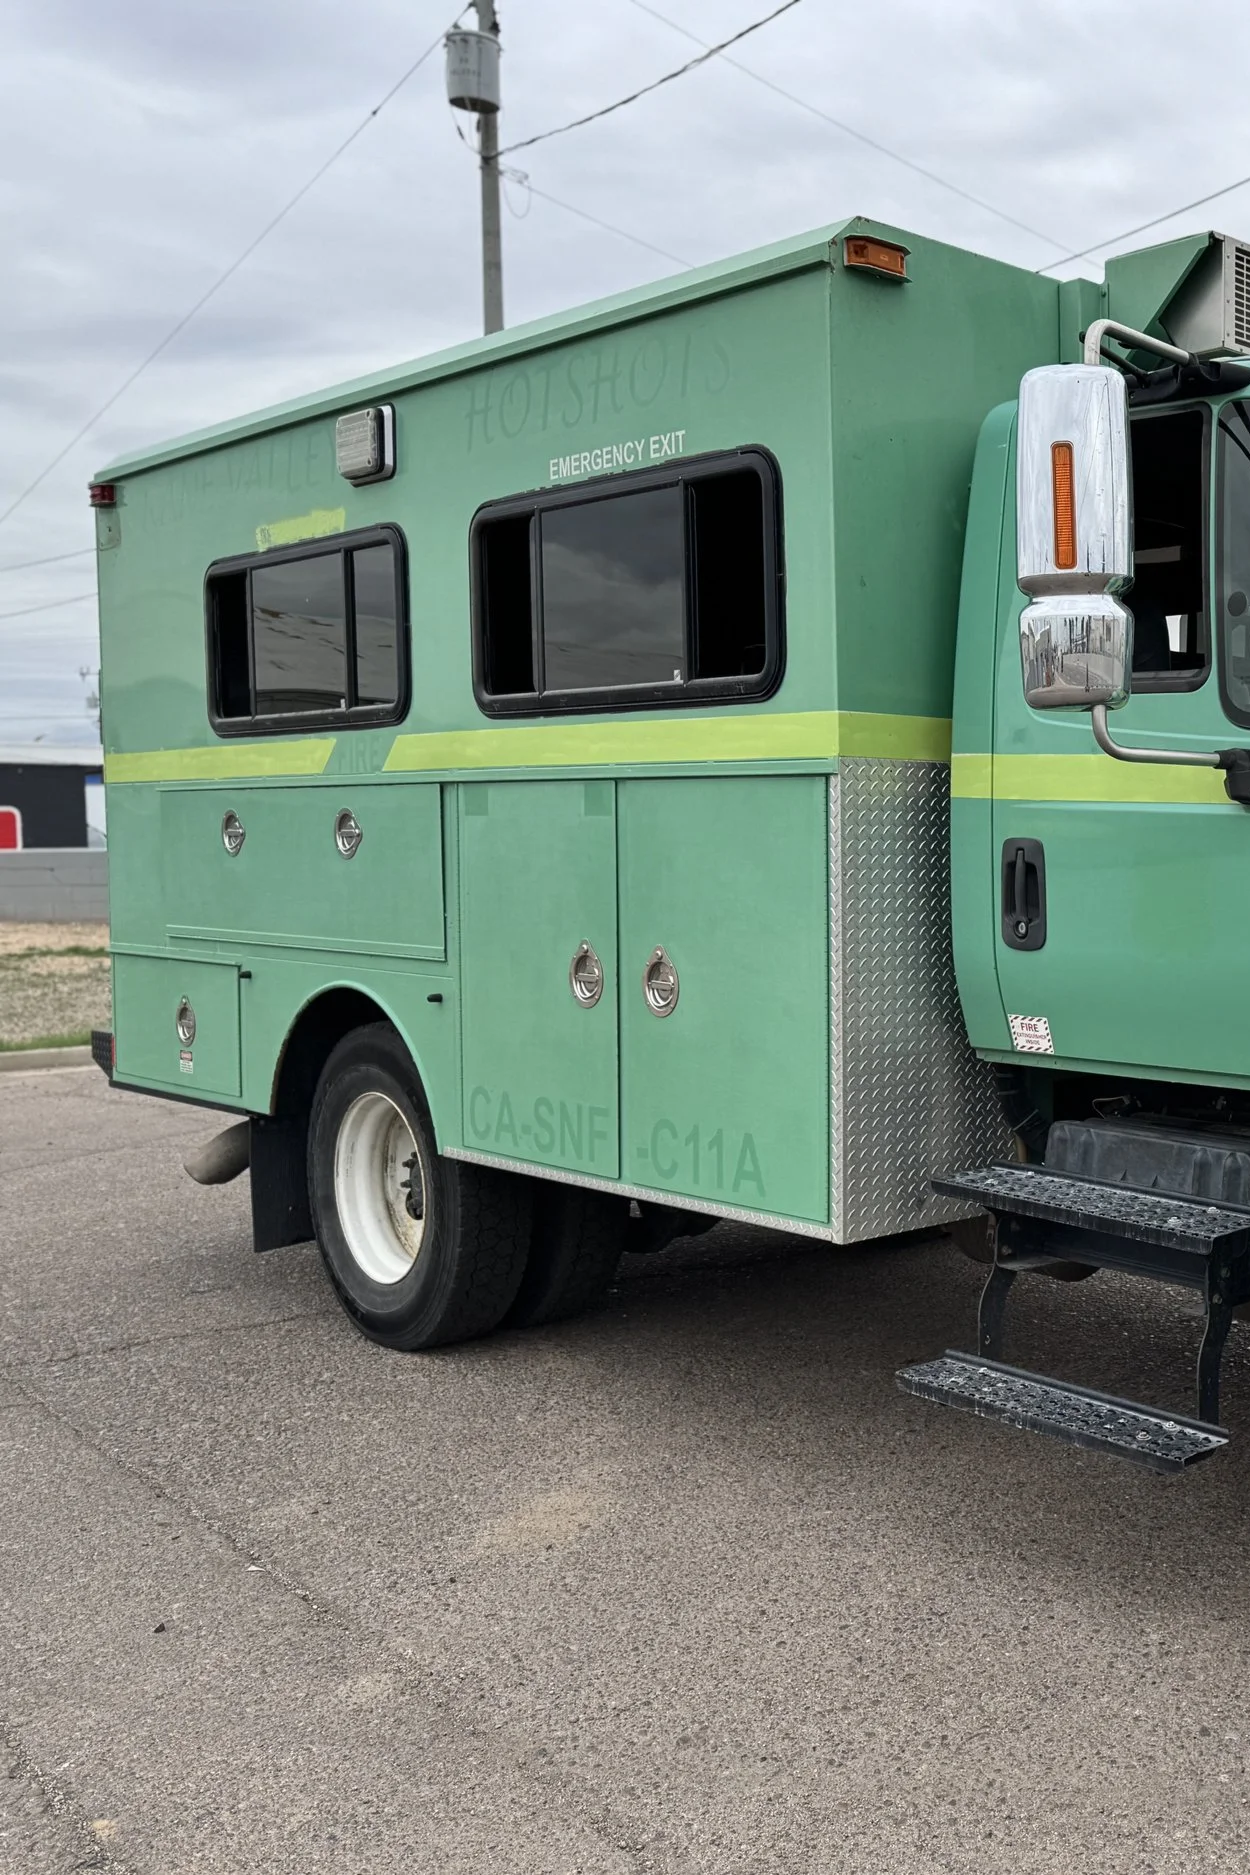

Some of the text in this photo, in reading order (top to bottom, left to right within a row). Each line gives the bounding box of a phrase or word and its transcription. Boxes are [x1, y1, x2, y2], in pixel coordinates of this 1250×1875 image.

[549, 429, 686, 480] EMERGENCY EXIT
[1020, 1022, 1039, 1032] FIRE
[469, 1084, 611, 1163] CA-SNF
